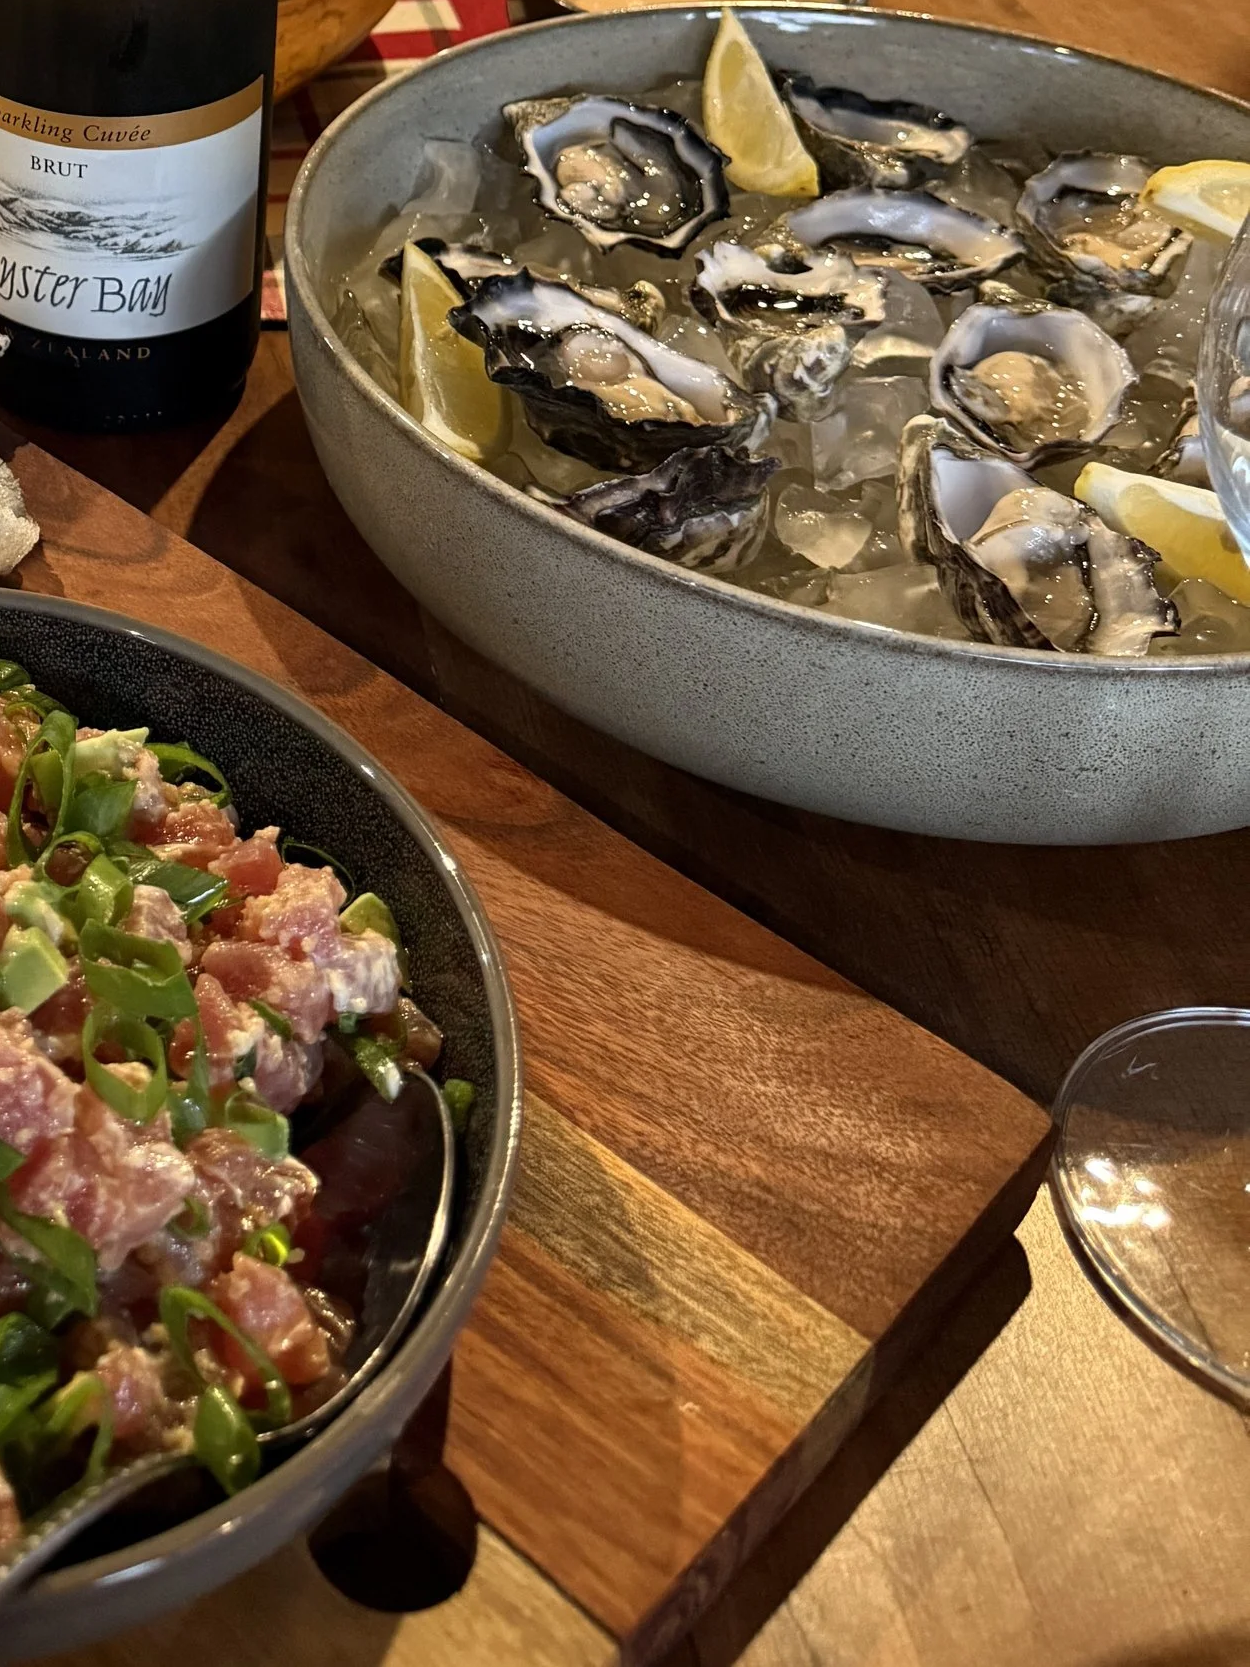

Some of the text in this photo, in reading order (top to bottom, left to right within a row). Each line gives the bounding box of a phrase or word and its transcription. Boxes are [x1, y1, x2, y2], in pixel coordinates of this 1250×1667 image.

[83, 123, 152, 143] Cuvée
[30, 155, 89, 179] BRUT
[90, 272, 173, 317] Bay
